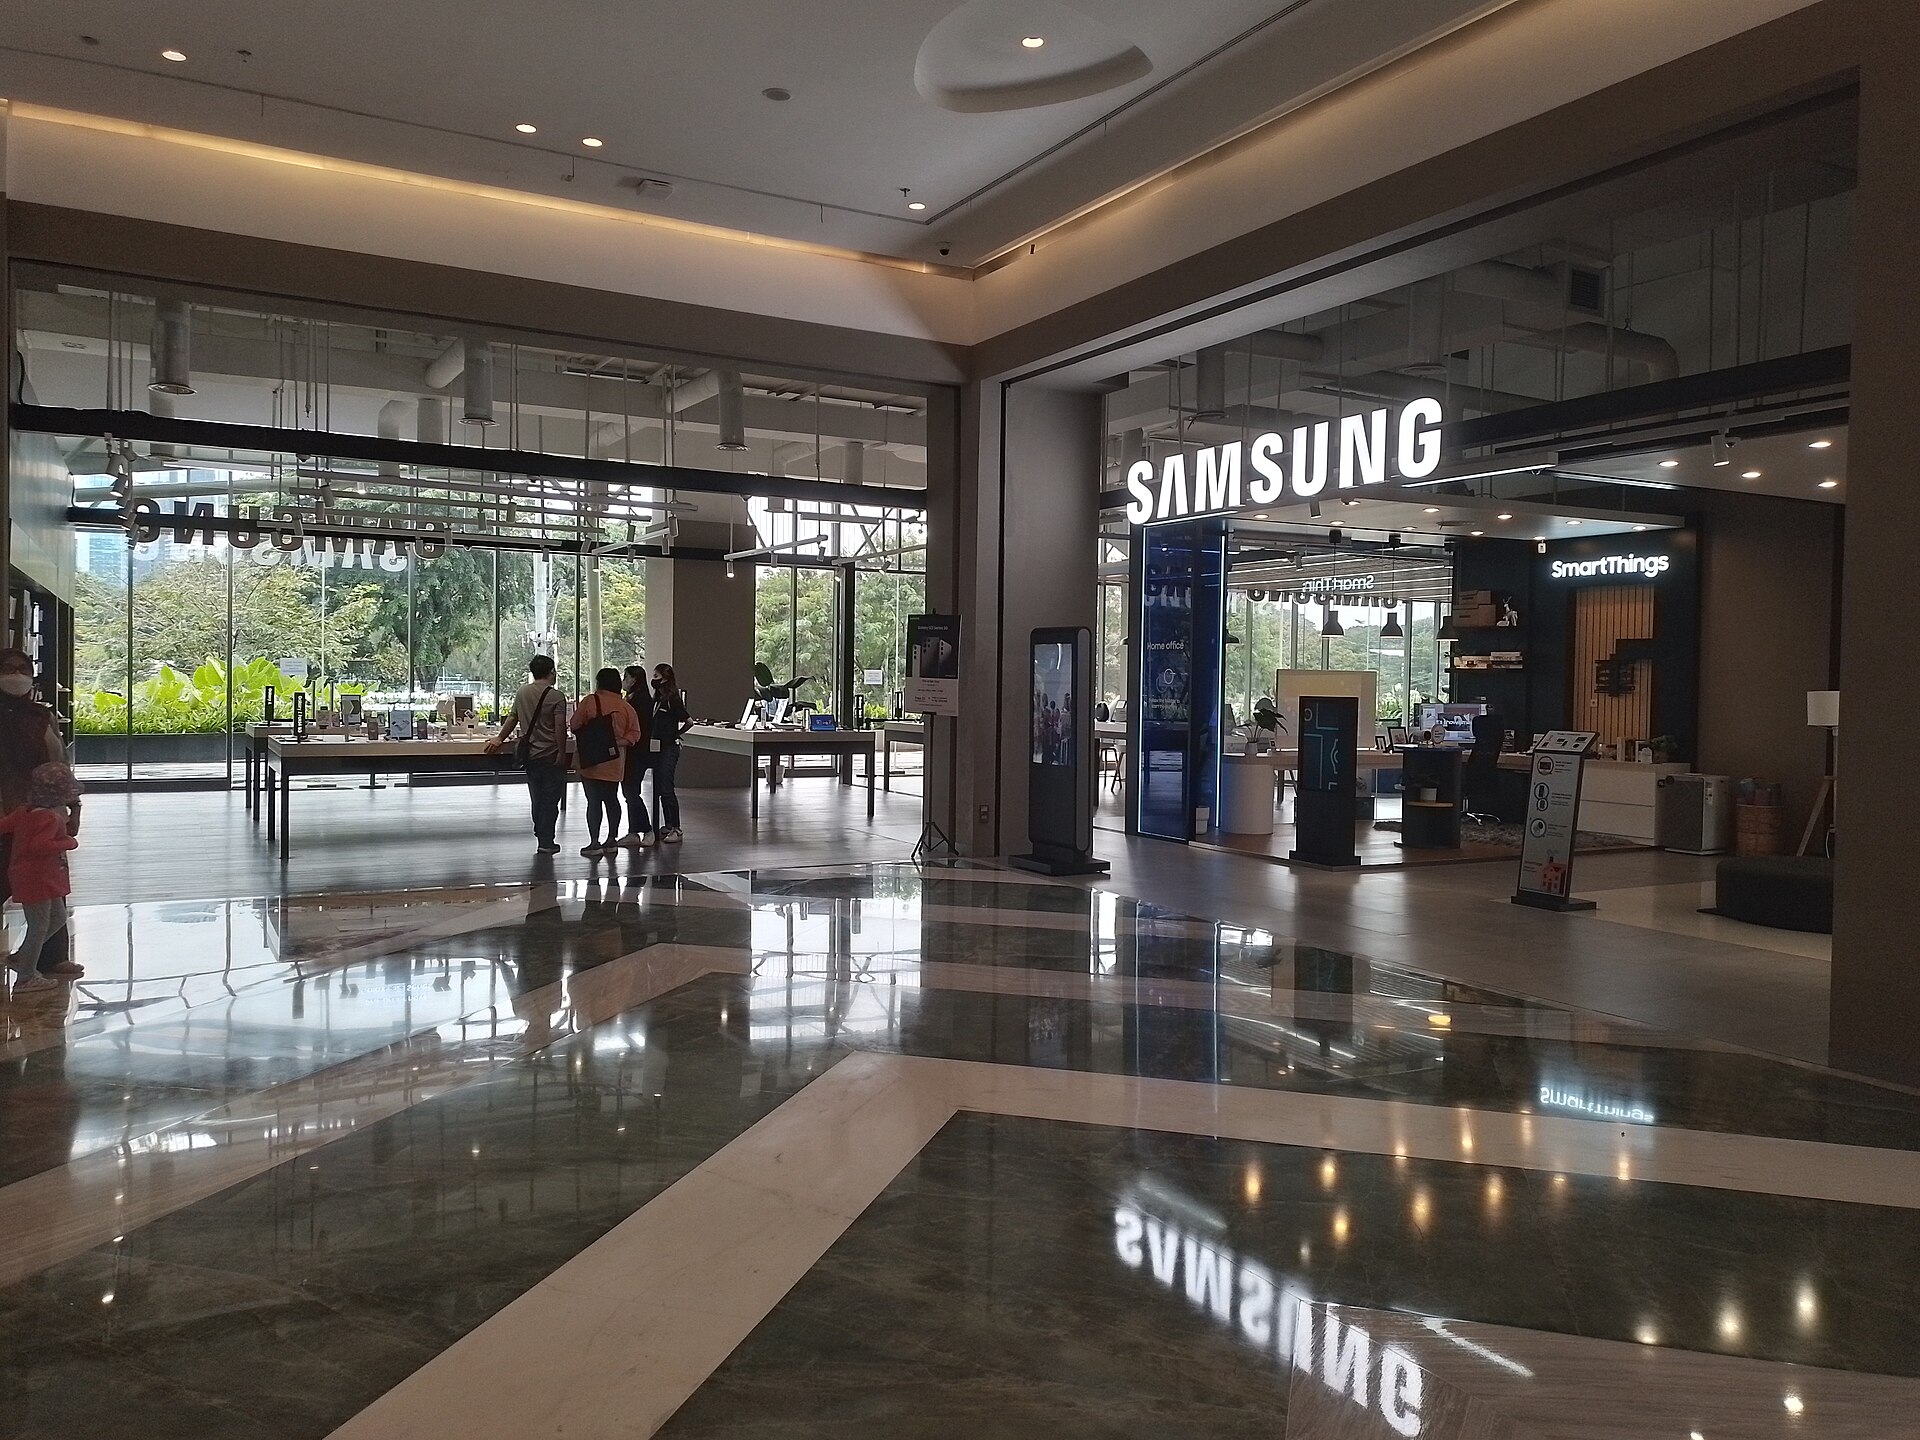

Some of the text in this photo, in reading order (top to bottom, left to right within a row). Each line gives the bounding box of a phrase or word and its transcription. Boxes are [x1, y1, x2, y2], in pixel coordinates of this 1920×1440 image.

[1126, 396, 1443, 525] SAMSUNG
[1551, 553, 1670, 578] SmartThings
[1146, 641, 1185, 650] Home office
